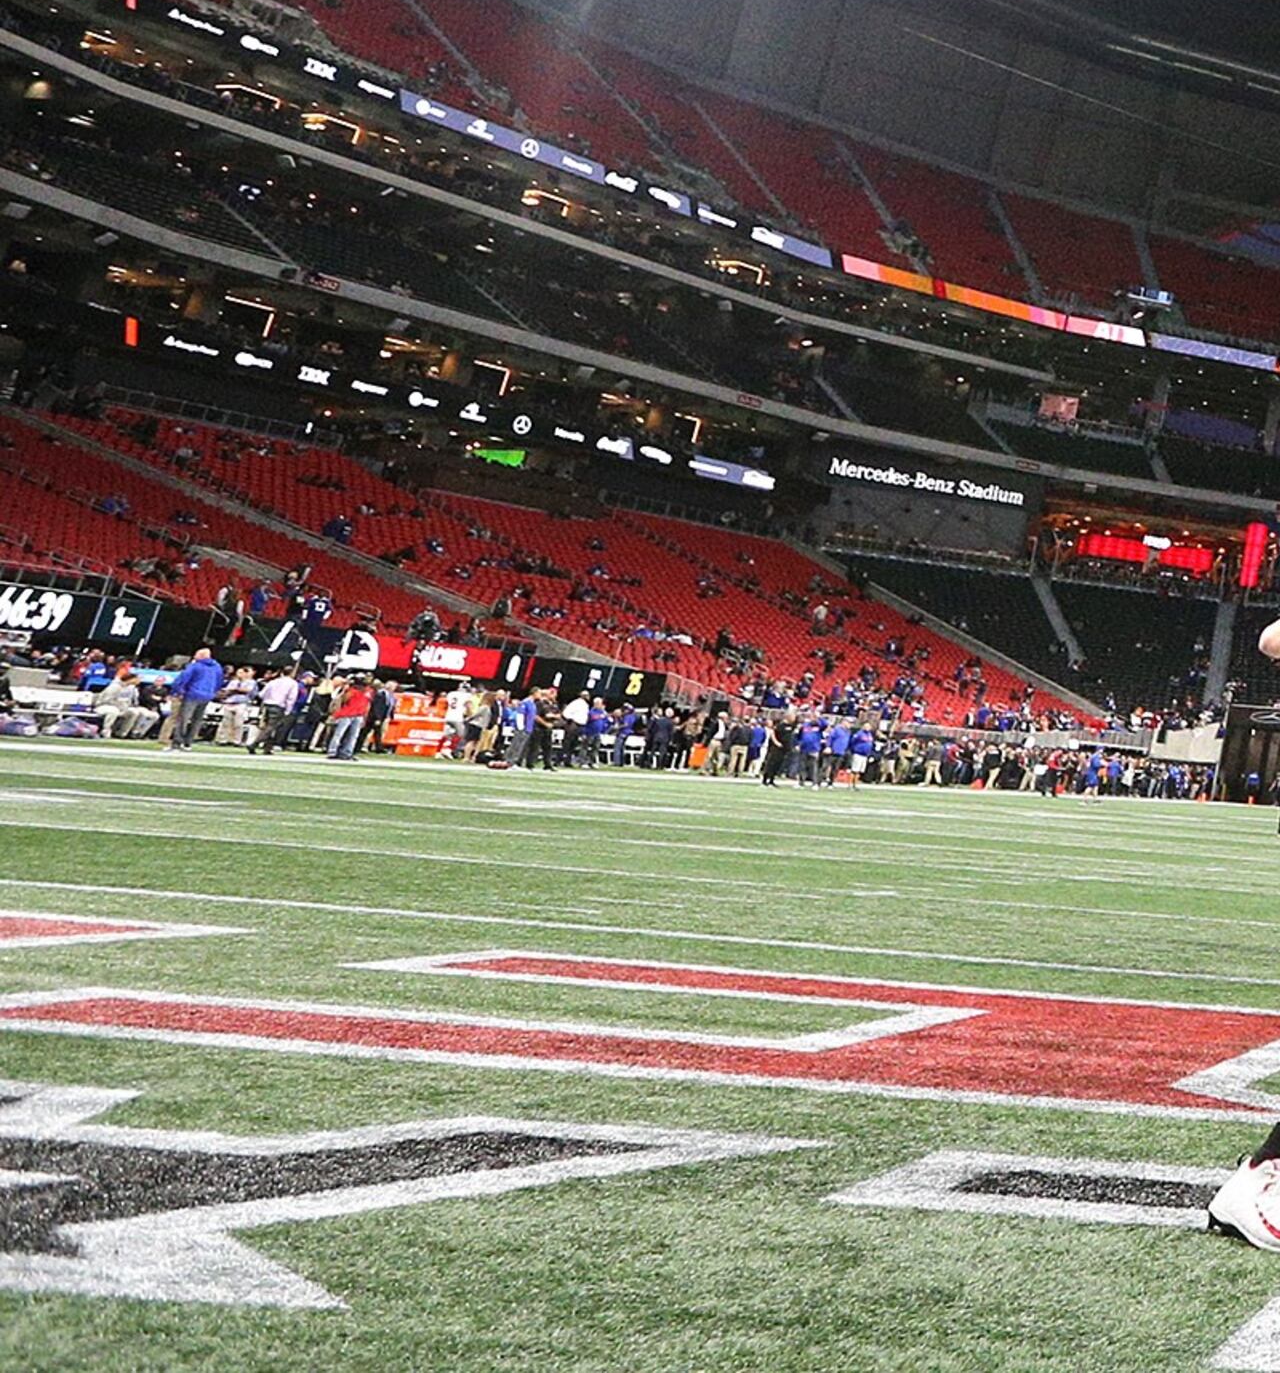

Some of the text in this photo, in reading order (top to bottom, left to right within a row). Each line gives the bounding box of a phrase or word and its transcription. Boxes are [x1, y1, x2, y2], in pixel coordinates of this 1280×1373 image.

[829, 458, 1024, 505] Mercedes-Benz Stadium
[0, 586, 74, 631] 66:39
